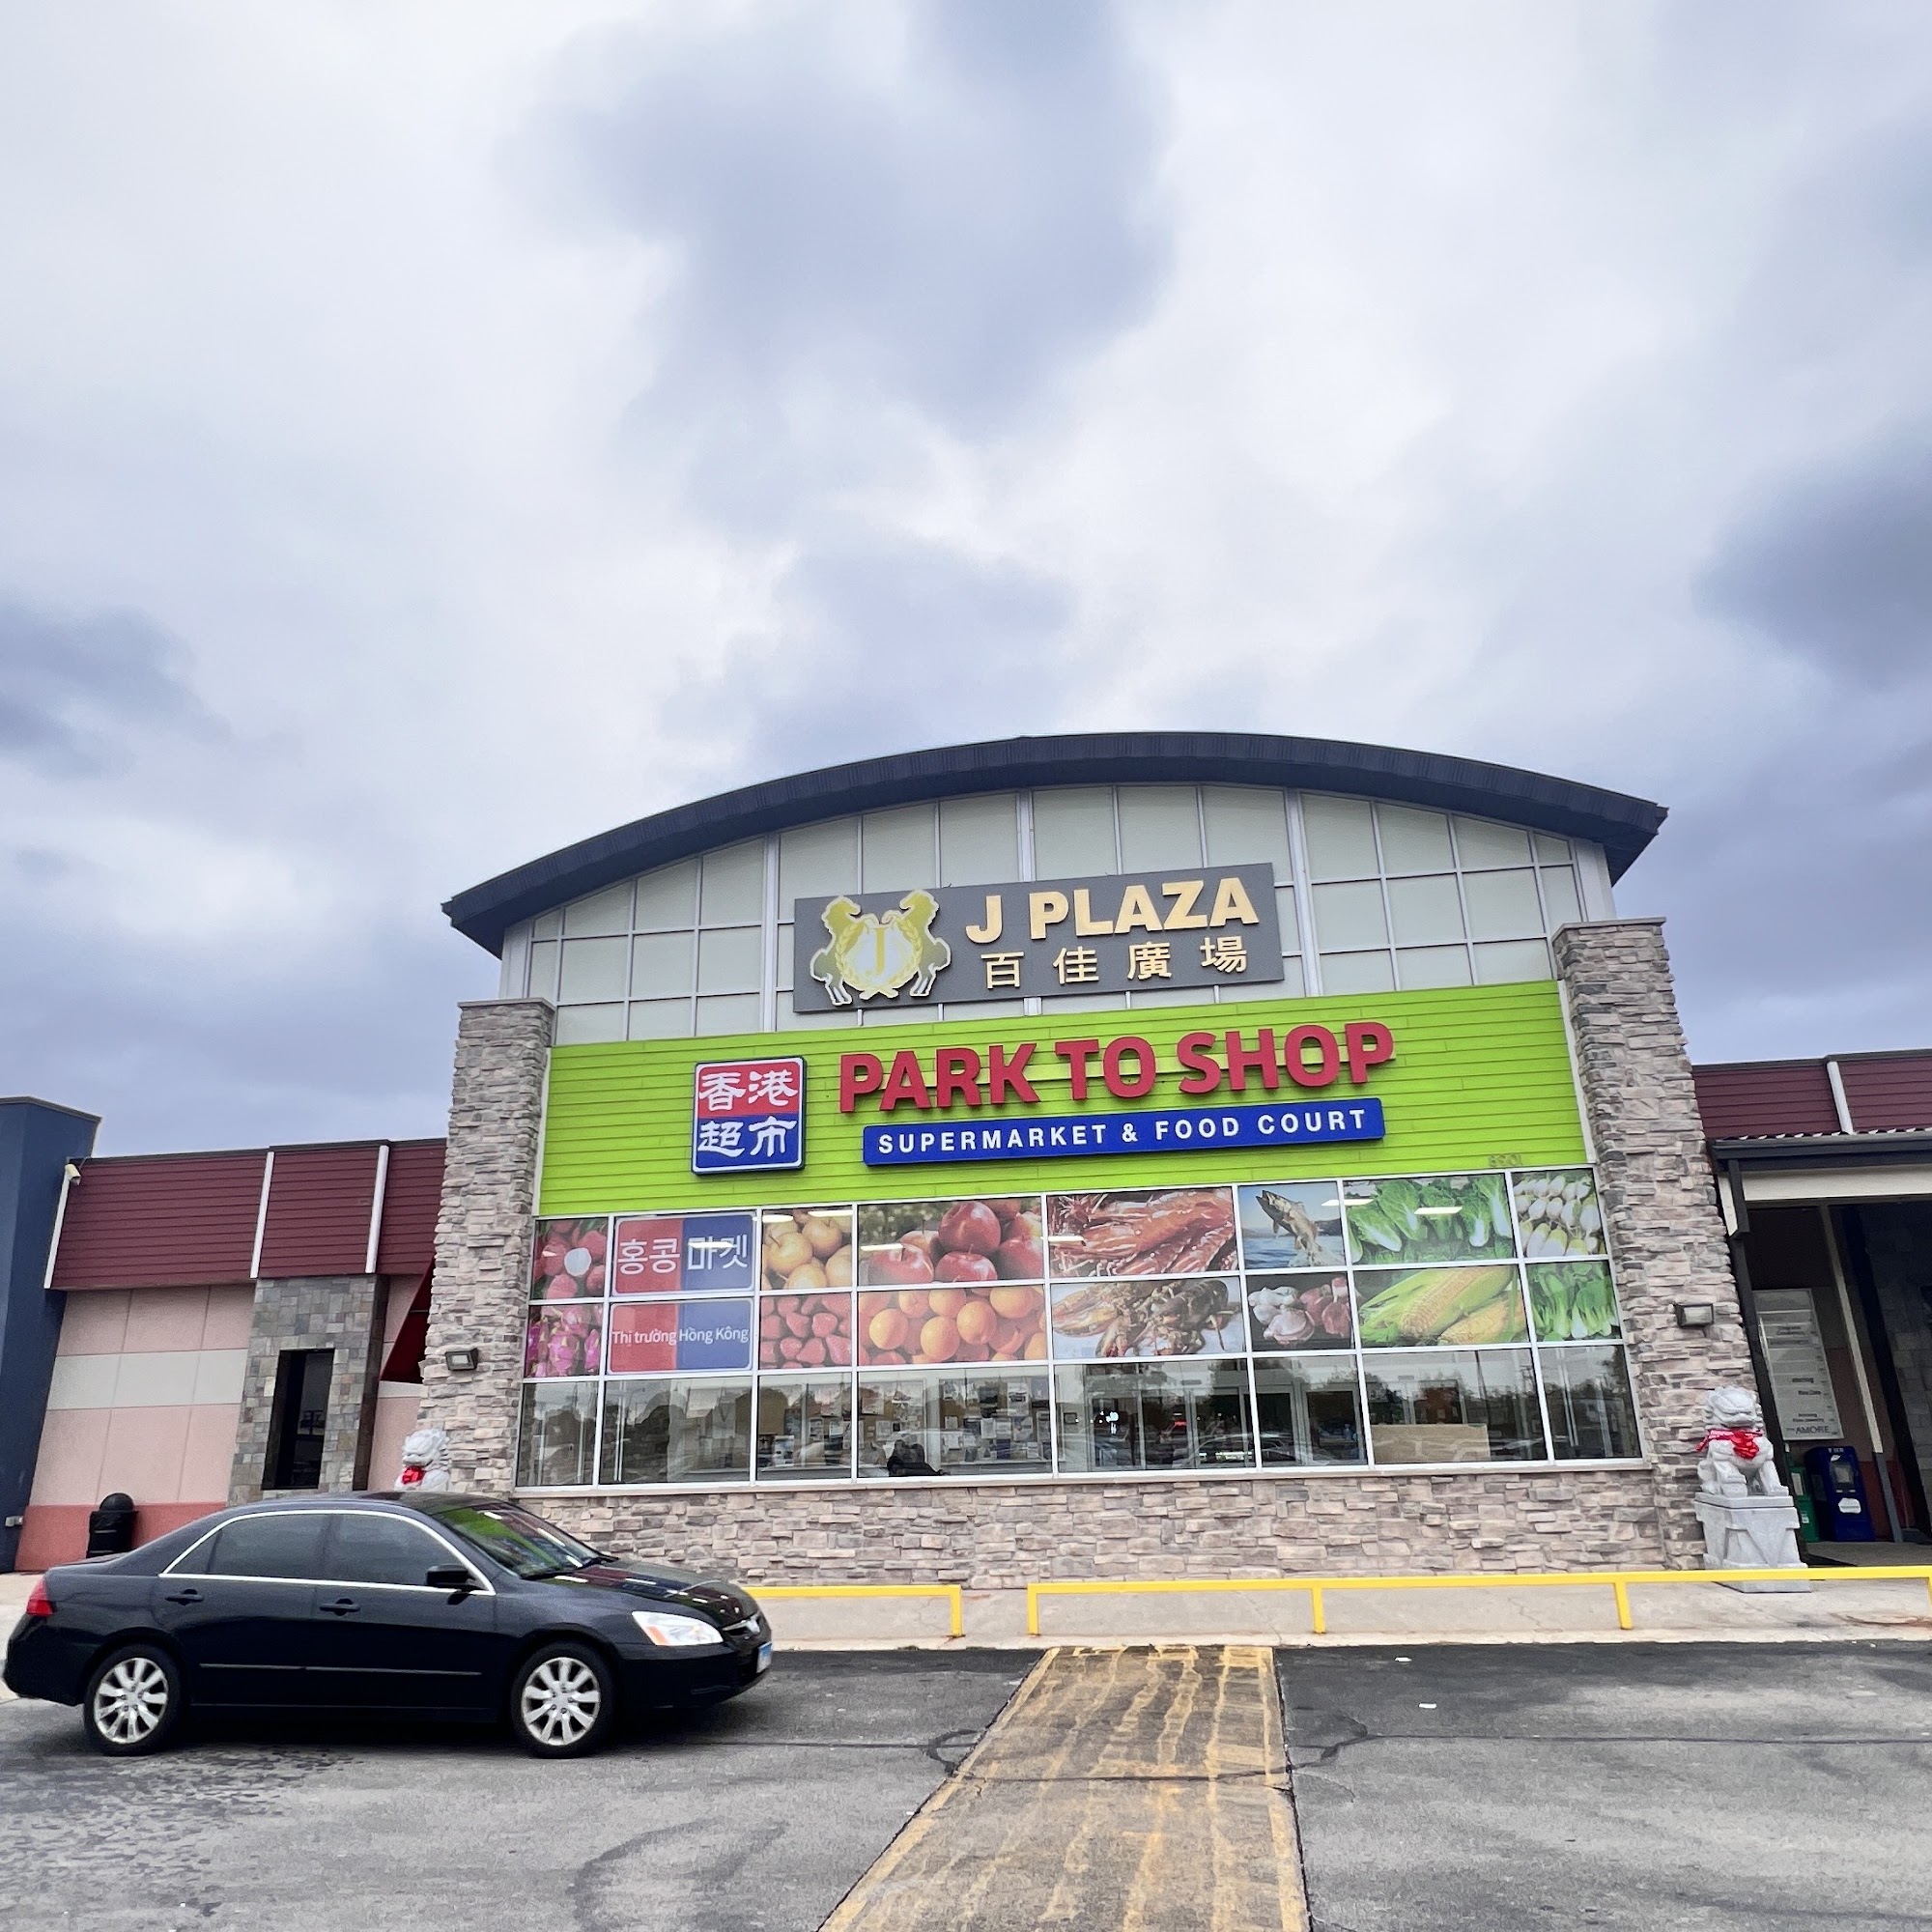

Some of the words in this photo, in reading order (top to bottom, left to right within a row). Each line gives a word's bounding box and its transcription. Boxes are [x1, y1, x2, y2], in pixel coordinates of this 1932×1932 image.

[966, 895, 1002, 944] J
[1030, 877, 1259, 939] PLAZA
[980, 936, 1248, 989] 百佳廣場
[839, 1042, 1041, 1113] PARK
[1055, 1036, 1157, 1100] TO
[1177, 1022, 1394, 1094] SHOP
[698, 1069, 799, 1112] 香港
[697, 1116, 797, 1157] 超市
[878, 1124, 1107, 1154] SUPERMARKET
[1122, 1123, 1137, 1142] &
[1155, 1117, 1239, 1141] FOOD
[1258, 1109, 1365, 1135] COURT
[618, 1237, 680, 1275] 홍콩
[688, 1234, 748, 1270] 마켓
[611, 1330, 632, 1347] Thị
[679, 1326, 714, 1345] Hồng
[715, 1325, 750, 1344] Kông
